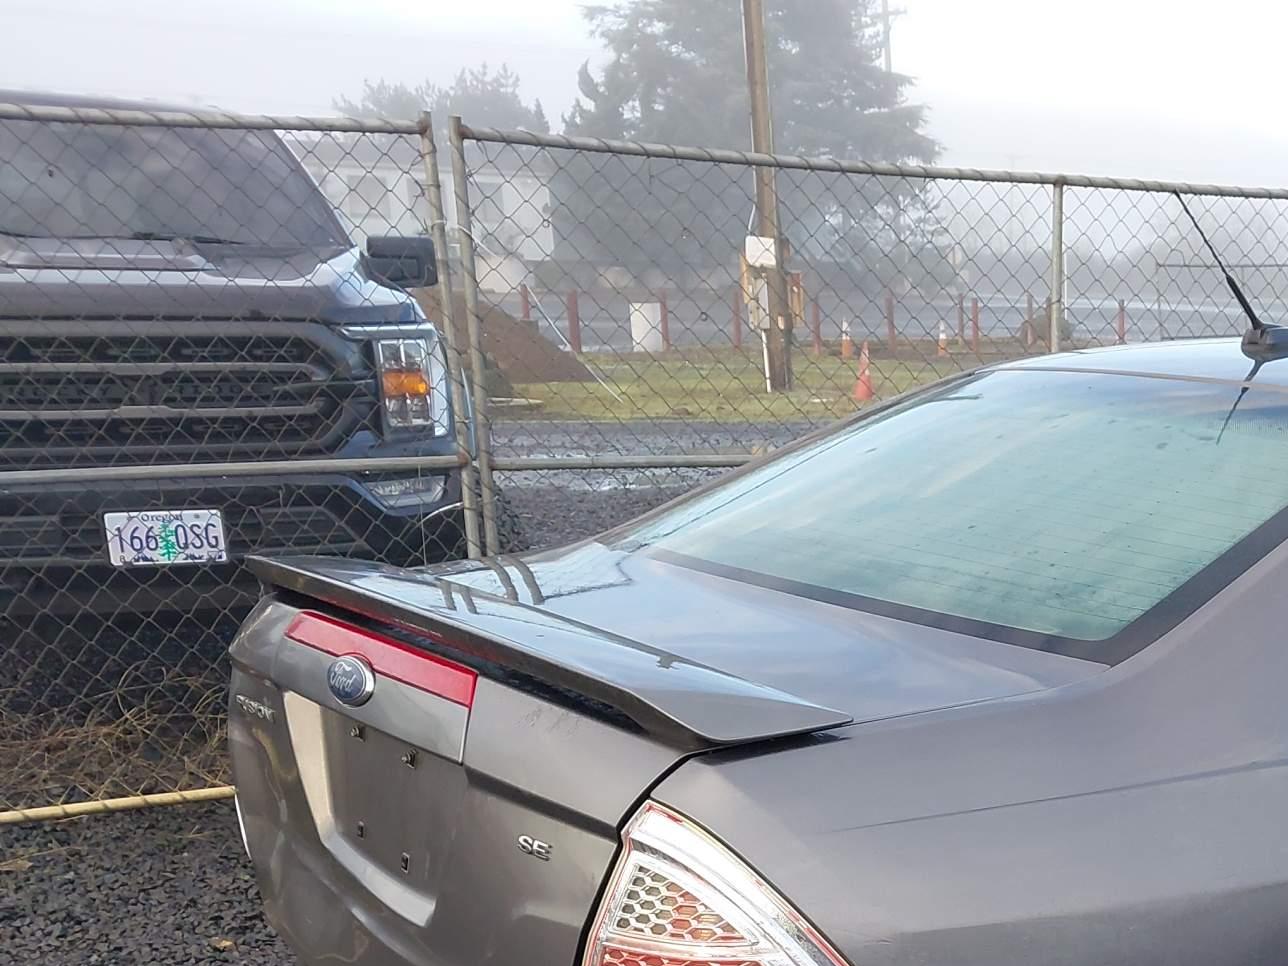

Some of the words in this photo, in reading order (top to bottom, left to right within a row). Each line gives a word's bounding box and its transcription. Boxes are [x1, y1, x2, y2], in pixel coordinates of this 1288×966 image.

[115, 526, 158, 553] 166
[330, 661, 357, 692] Ford
[518, 835, 551, 861] SE
